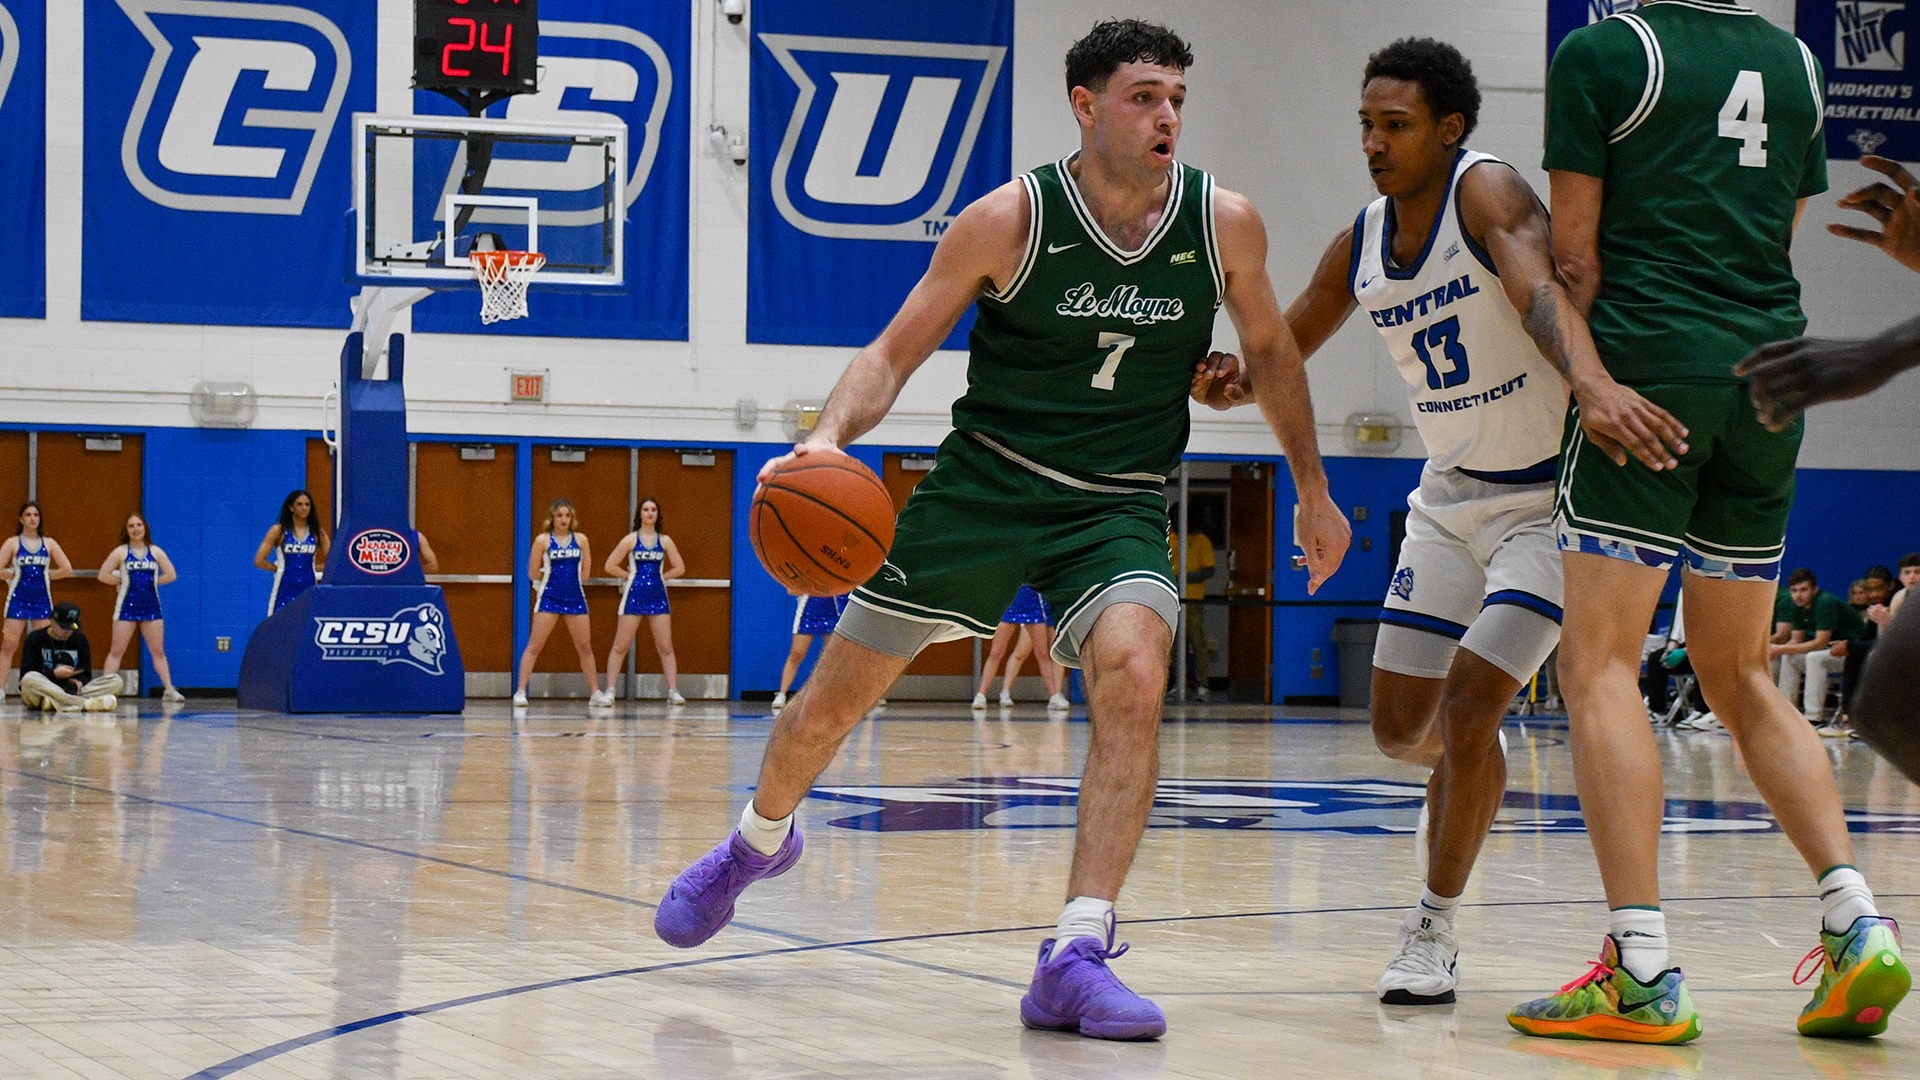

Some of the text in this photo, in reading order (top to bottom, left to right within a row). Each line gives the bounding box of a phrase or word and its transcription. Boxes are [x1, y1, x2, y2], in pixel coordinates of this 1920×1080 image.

[441, 17, 513, 77] 24
[1718, 70, 1768, 168] 4
[1170, 250, 1196, 264] NEC
[1370, 274, 1480, 328] CENTRAL
[1091, 332, 1136, 391] 7
[1411, 315, 1470, 390] 13
[516, 376, 542, 396] EXIT
[1417, 373, 1527, 413] CONNECTICUT
[284, 543, 316, 553] CCSU
[357, 537, 402, 555] Jersey
[550, 549, 580, 559] CCSU
[634, 551, 664, 560] CCSU
[126, 561, 157, 570] CCSU
[319, 622, 411, 644] CCSU
